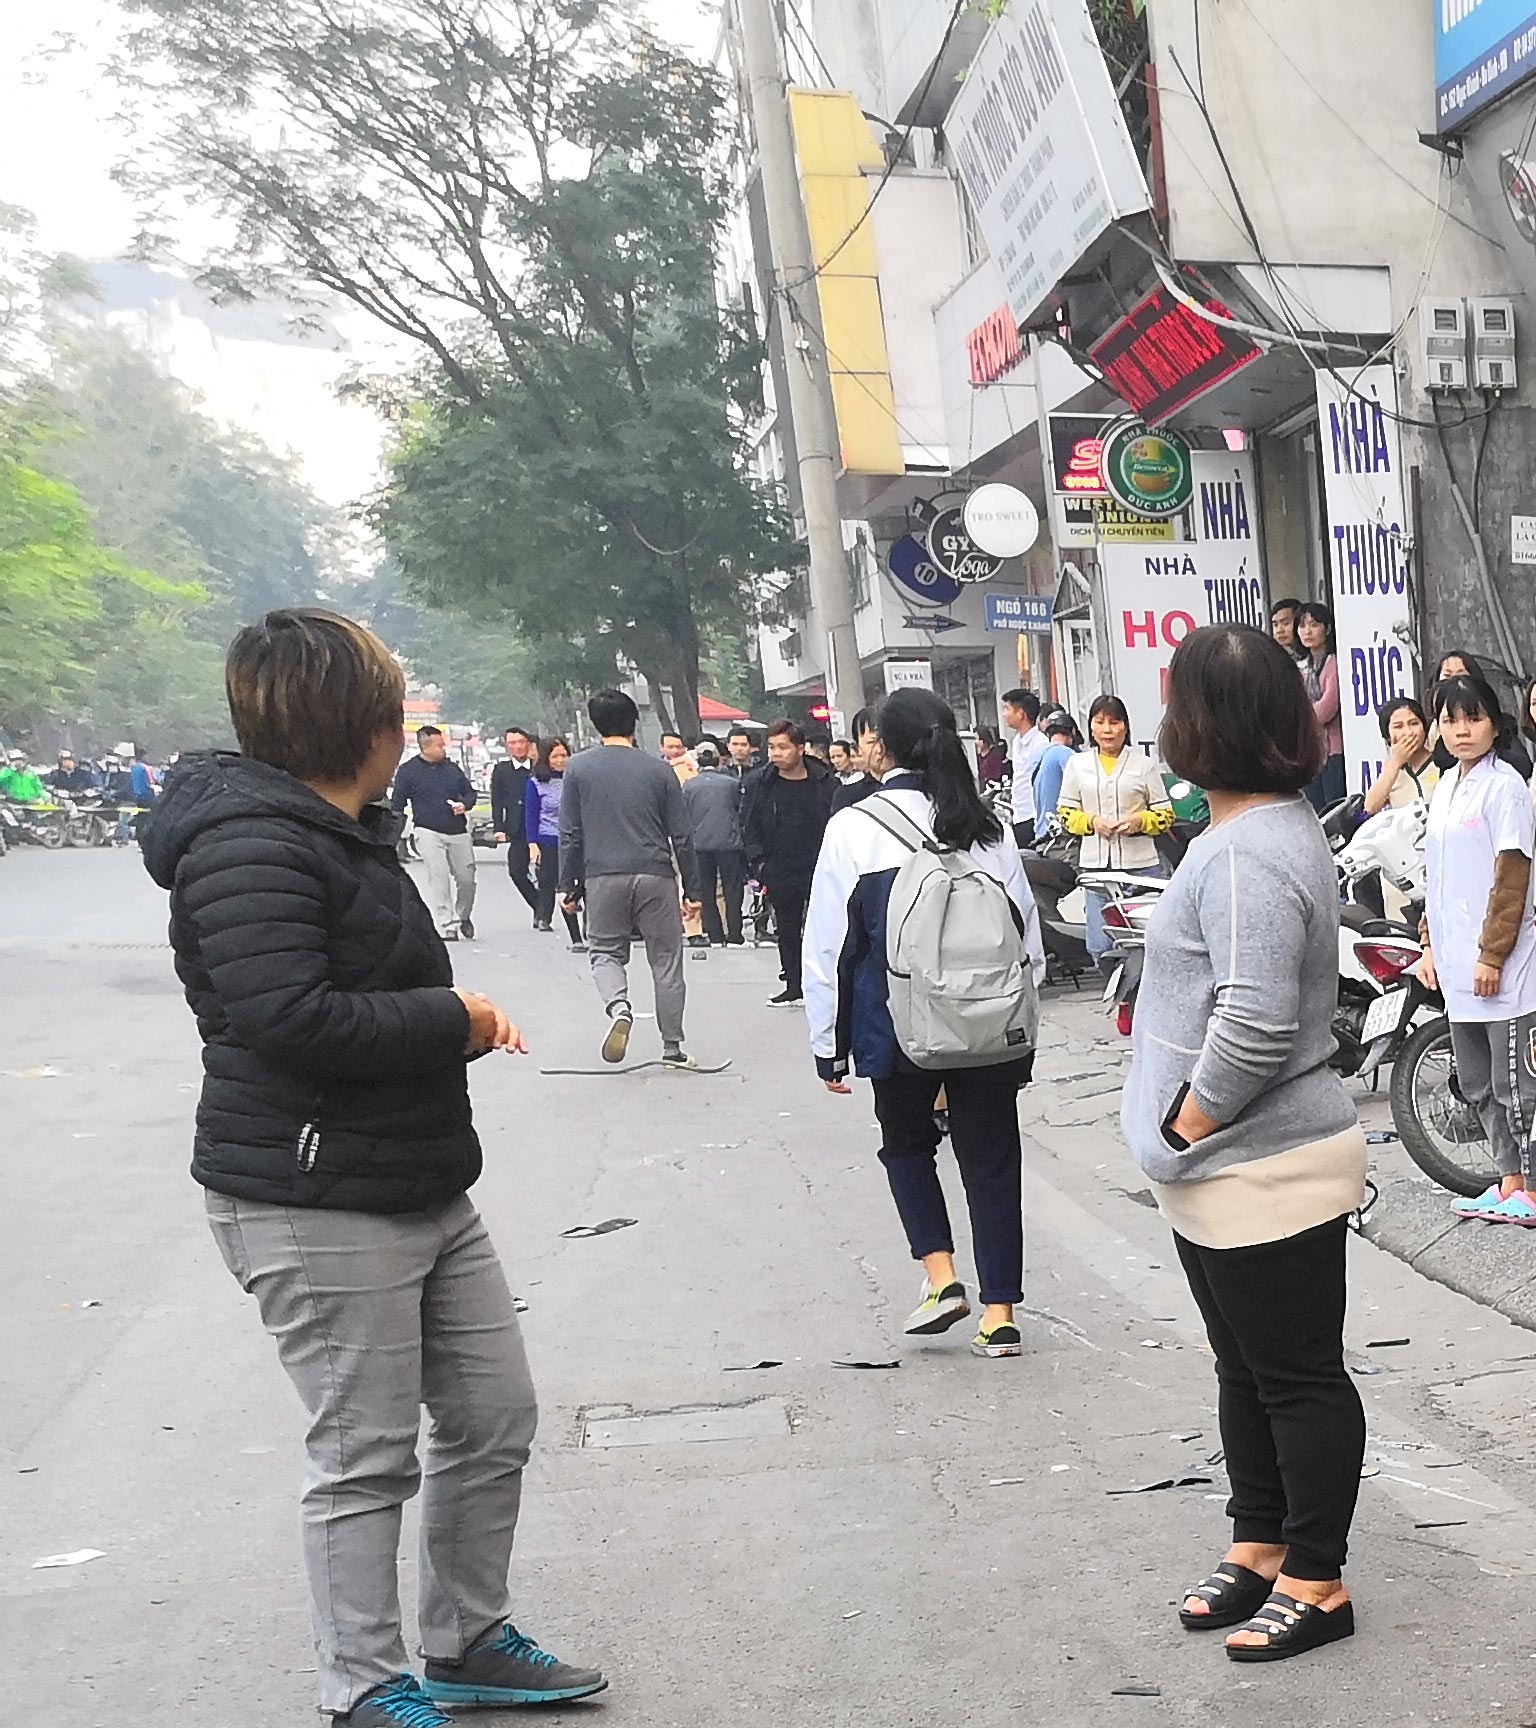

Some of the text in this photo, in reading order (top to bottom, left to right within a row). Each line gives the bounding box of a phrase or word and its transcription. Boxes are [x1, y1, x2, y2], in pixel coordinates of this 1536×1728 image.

[1020, 1, 1064, 110] ANH
[1329, 384, 1391, 475] NHÀ
[996, 511, 1031, 522] SWEET
[1200, 468, 1251, 540] NHÀ
[916, 564, 934, 584] 10
[942, 535, 977, 551] GY
[944, 551, 991, 583] Yoga
[1144, 553, 1197, 576] NHÀ
[1334, 496, 1405, 596] THUỐC
[1203, 557, 1263, 629] THUỐC
[1351, 631, 1405, 717] ĐỨC
